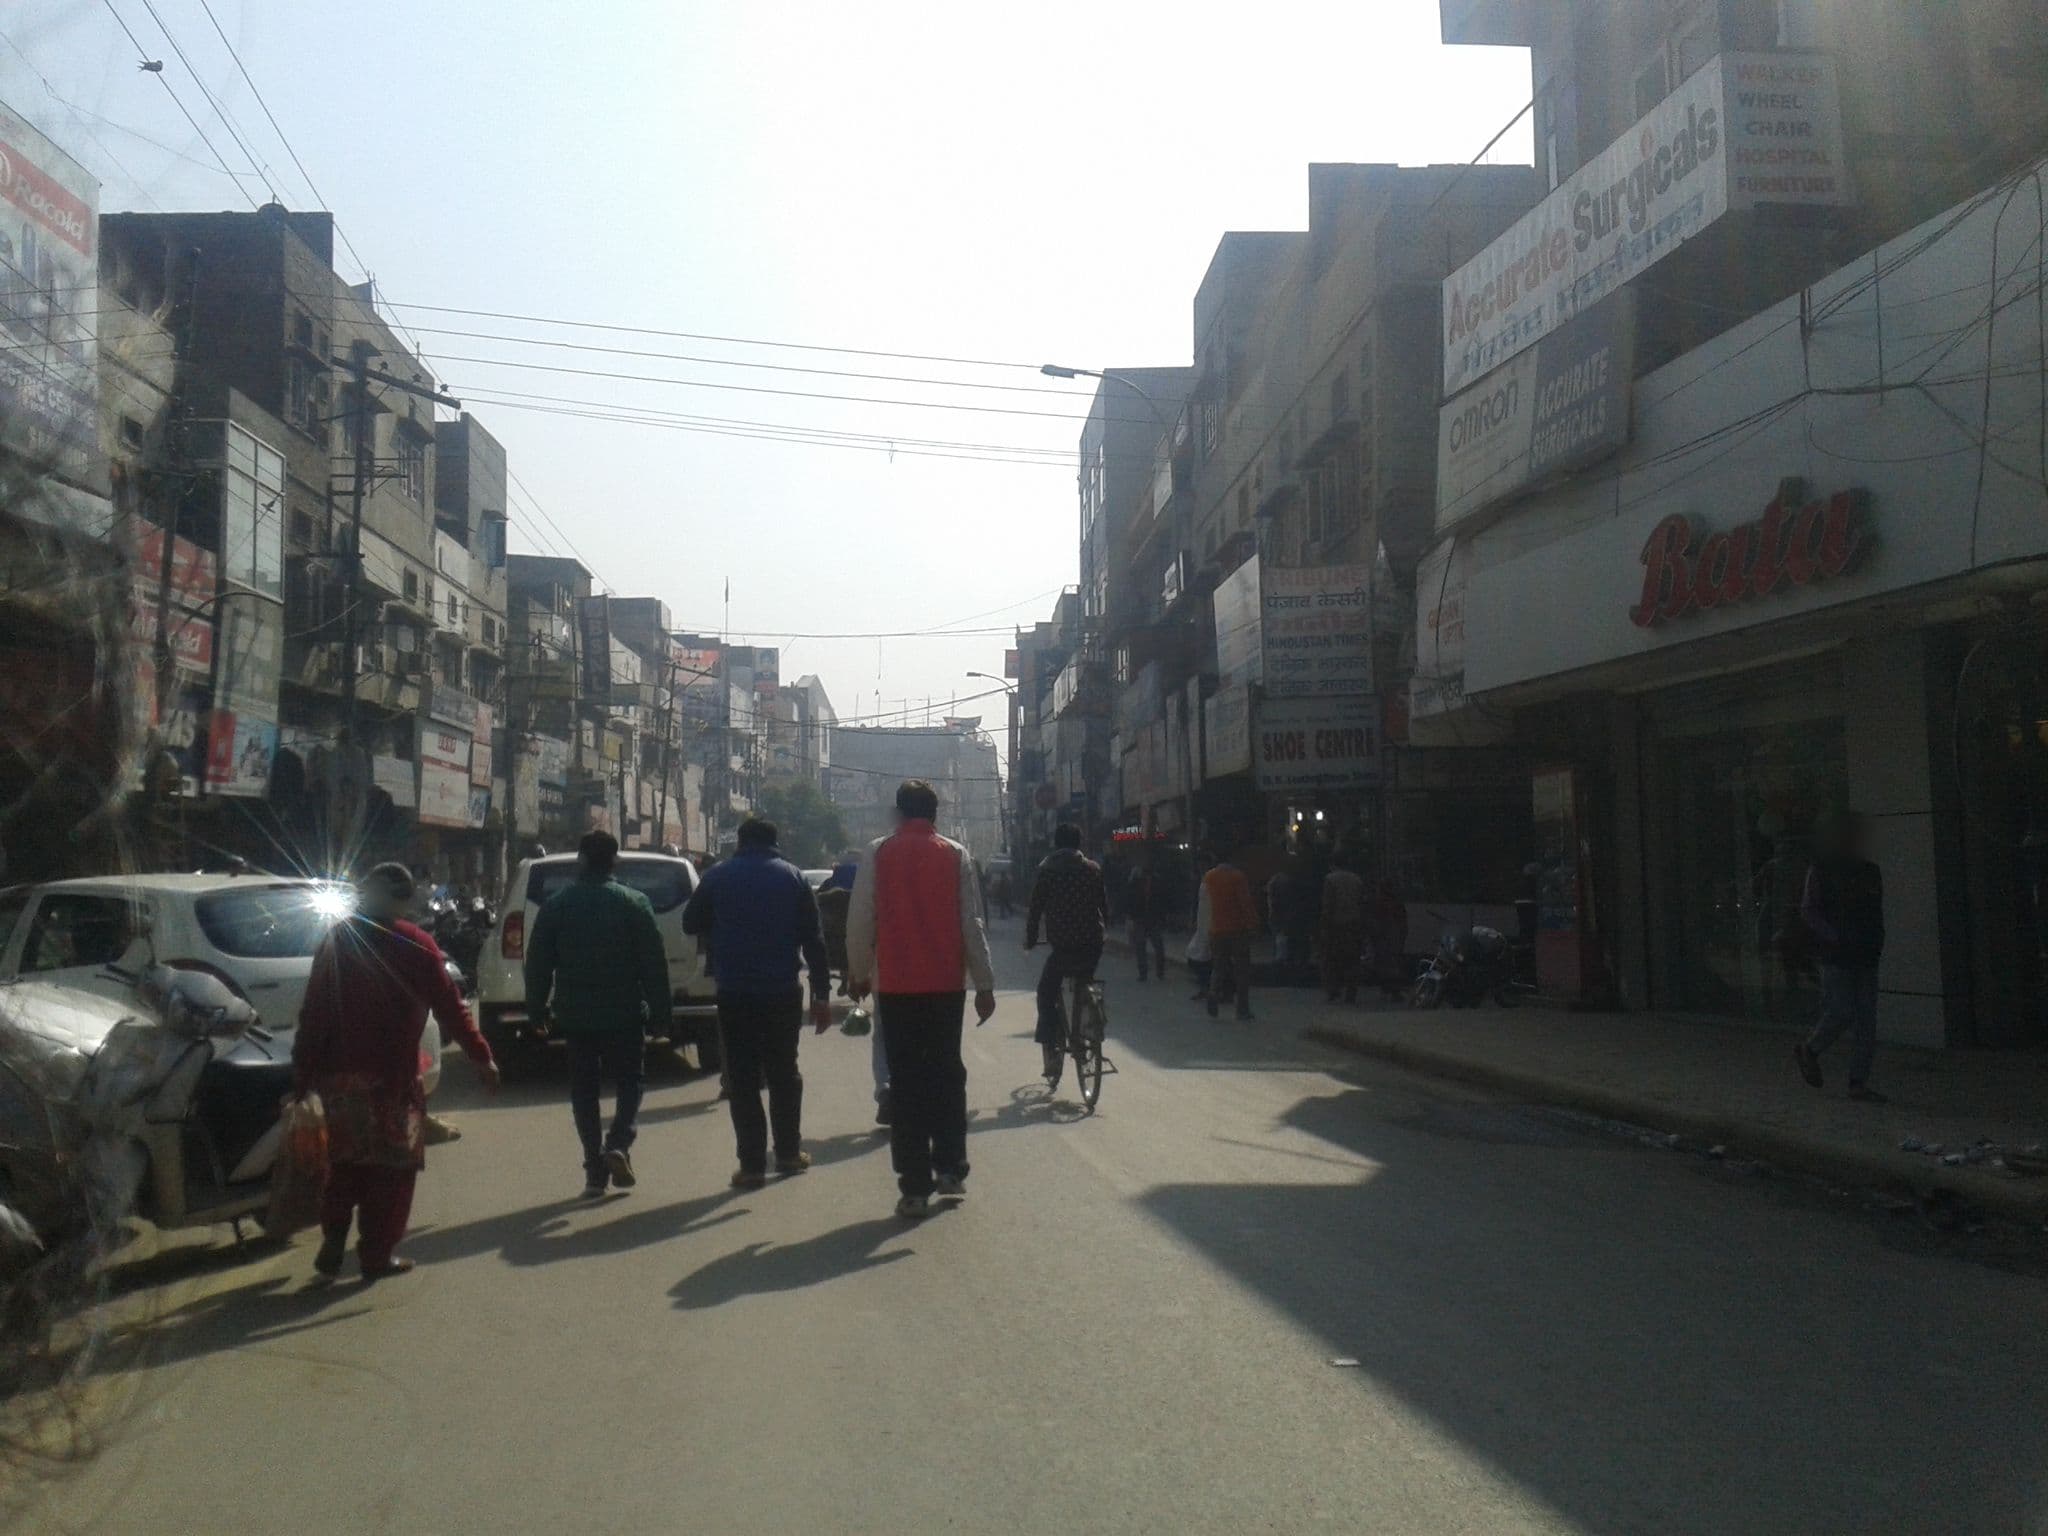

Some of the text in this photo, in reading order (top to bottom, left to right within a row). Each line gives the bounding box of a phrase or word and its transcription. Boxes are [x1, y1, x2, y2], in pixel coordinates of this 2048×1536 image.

[1737, 92, 1803, 110] WHEEL
[1745, 120, 1813, 138] CHAIR
[1736, 147, 1832, 165] HOSPITAL
[1736, 175, 1836, 193] FURNITURE
[1448, 228, 1568, 346] Accurate
[1573, 102, 1720, 253] Surgicals
[1630, 477, 1880, 628] Bata
[1266, 634, 1332, 649] HINDUSTAN
[1262, 730, 1306, 762] SHOE
[1315, 727, 1376, 759] CENTRE
